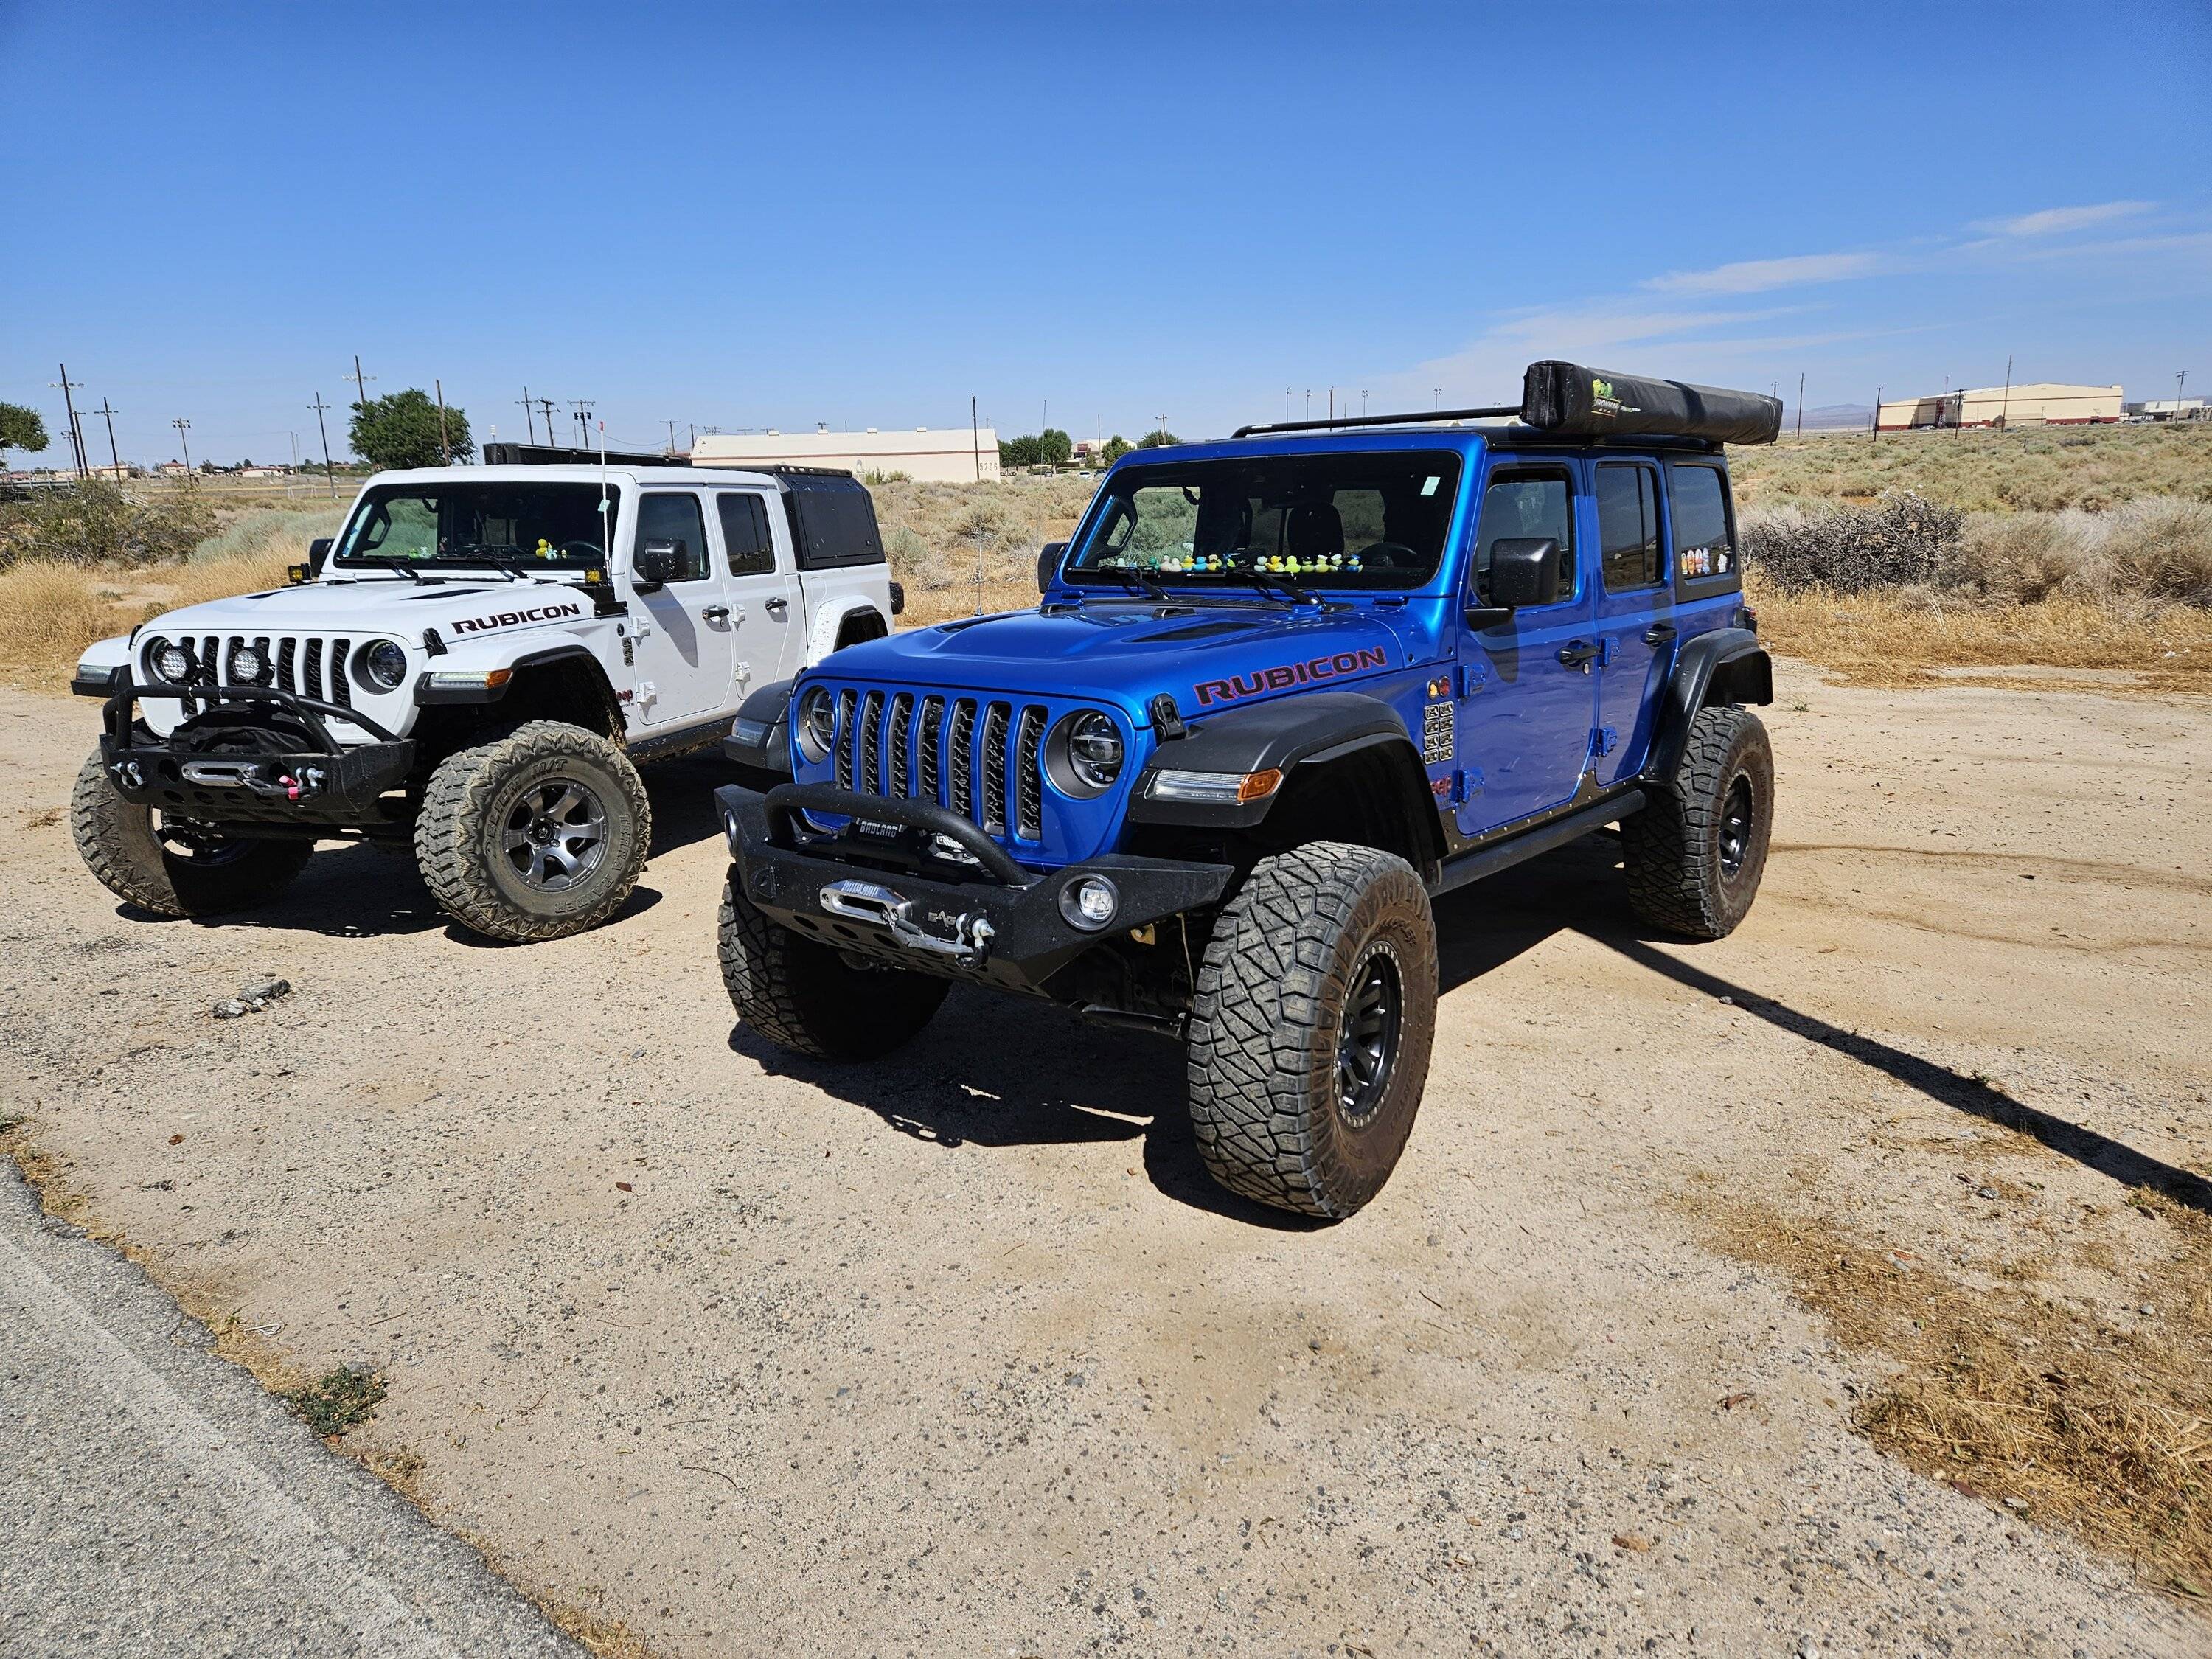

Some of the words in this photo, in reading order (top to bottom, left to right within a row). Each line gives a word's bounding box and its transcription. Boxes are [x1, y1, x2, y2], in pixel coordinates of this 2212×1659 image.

[451, 603, 580, 634] RUBICON
[1193, 646, 1387, 706] RUBICON
[532, 757, 568, 779] M/T
[859, 821, 899, 838] BADLAND
